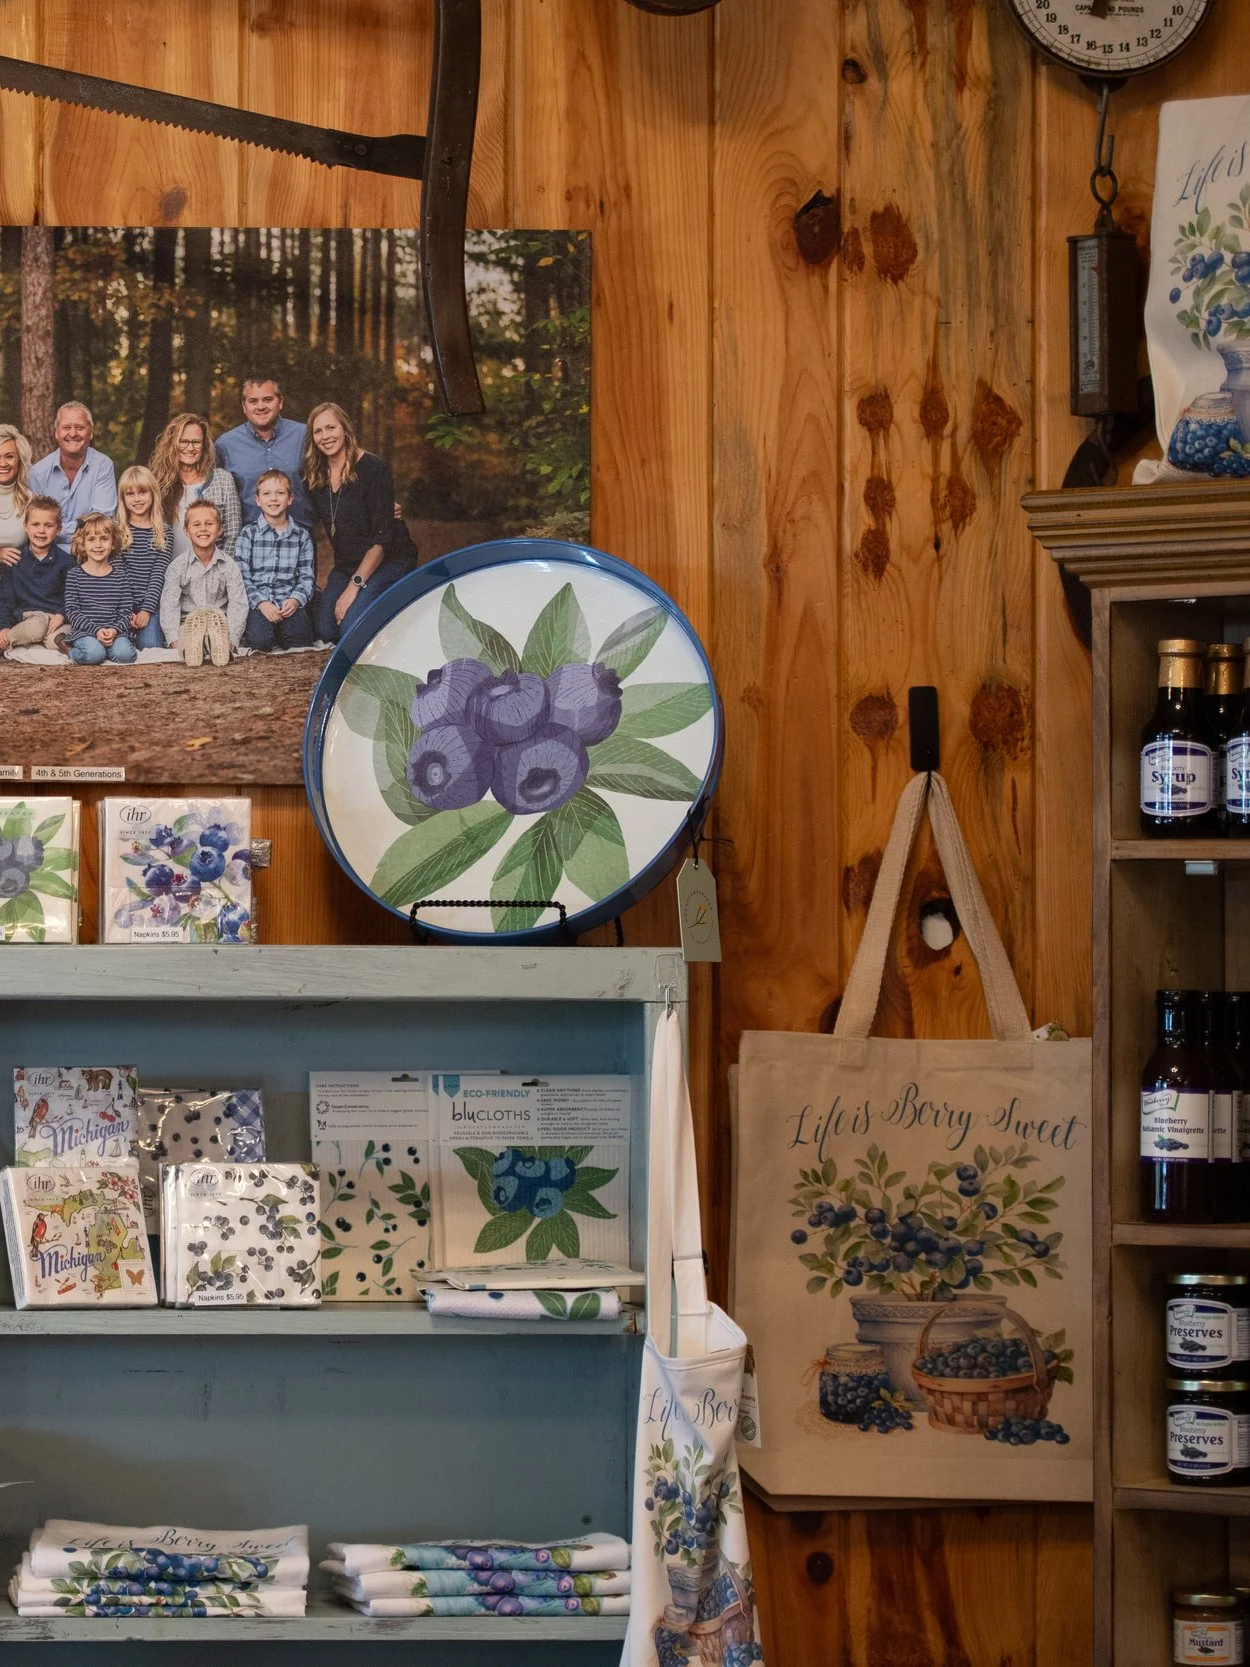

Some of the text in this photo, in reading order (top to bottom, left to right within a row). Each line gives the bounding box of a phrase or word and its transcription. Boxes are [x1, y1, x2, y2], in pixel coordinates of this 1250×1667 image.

[1036, 0, 1049, 8] 20
[1172, 6, 1183, 15] 10
[1046, 14, 1056, 22] 19
[1164, 18, 1173, 26] 11
[1058, 25, 1069, 34] 18
[1150, 30, 1161, 38] 12
[1071, 35, 1080, 43] 17
[1137, 38, 1148, 47] 13
[1086, 41, 1096, 50] 16
[1103, 45, 1113, 53] 15
[1119, 43, 1130, 51] 14
[1173, 140, 1248, 215] Life is
[74, 770, 122, 778] Generations
[1152, 771, 1196, 785] Syrup
[127, 807, 147, 821] ihr
[134, 931, 159, 939] Napkins
[34, 1073, 50, 1085] ihr
[786, 1082, 1087, 1164] Life is Berry Sweet
[1167, 1126, 1204, 1135] Vinaigrette
[39, 1118, 130, 1157] Michigan
[34, 1176, 51, 1189] ihr
[30, 1244, 106, 1282] Michigan
[1170, 1326, 1223, 1338] Preserves
[1170, 1432, 1223, 1445] Preserves
[150, 1528, 216, 1551] Berry
